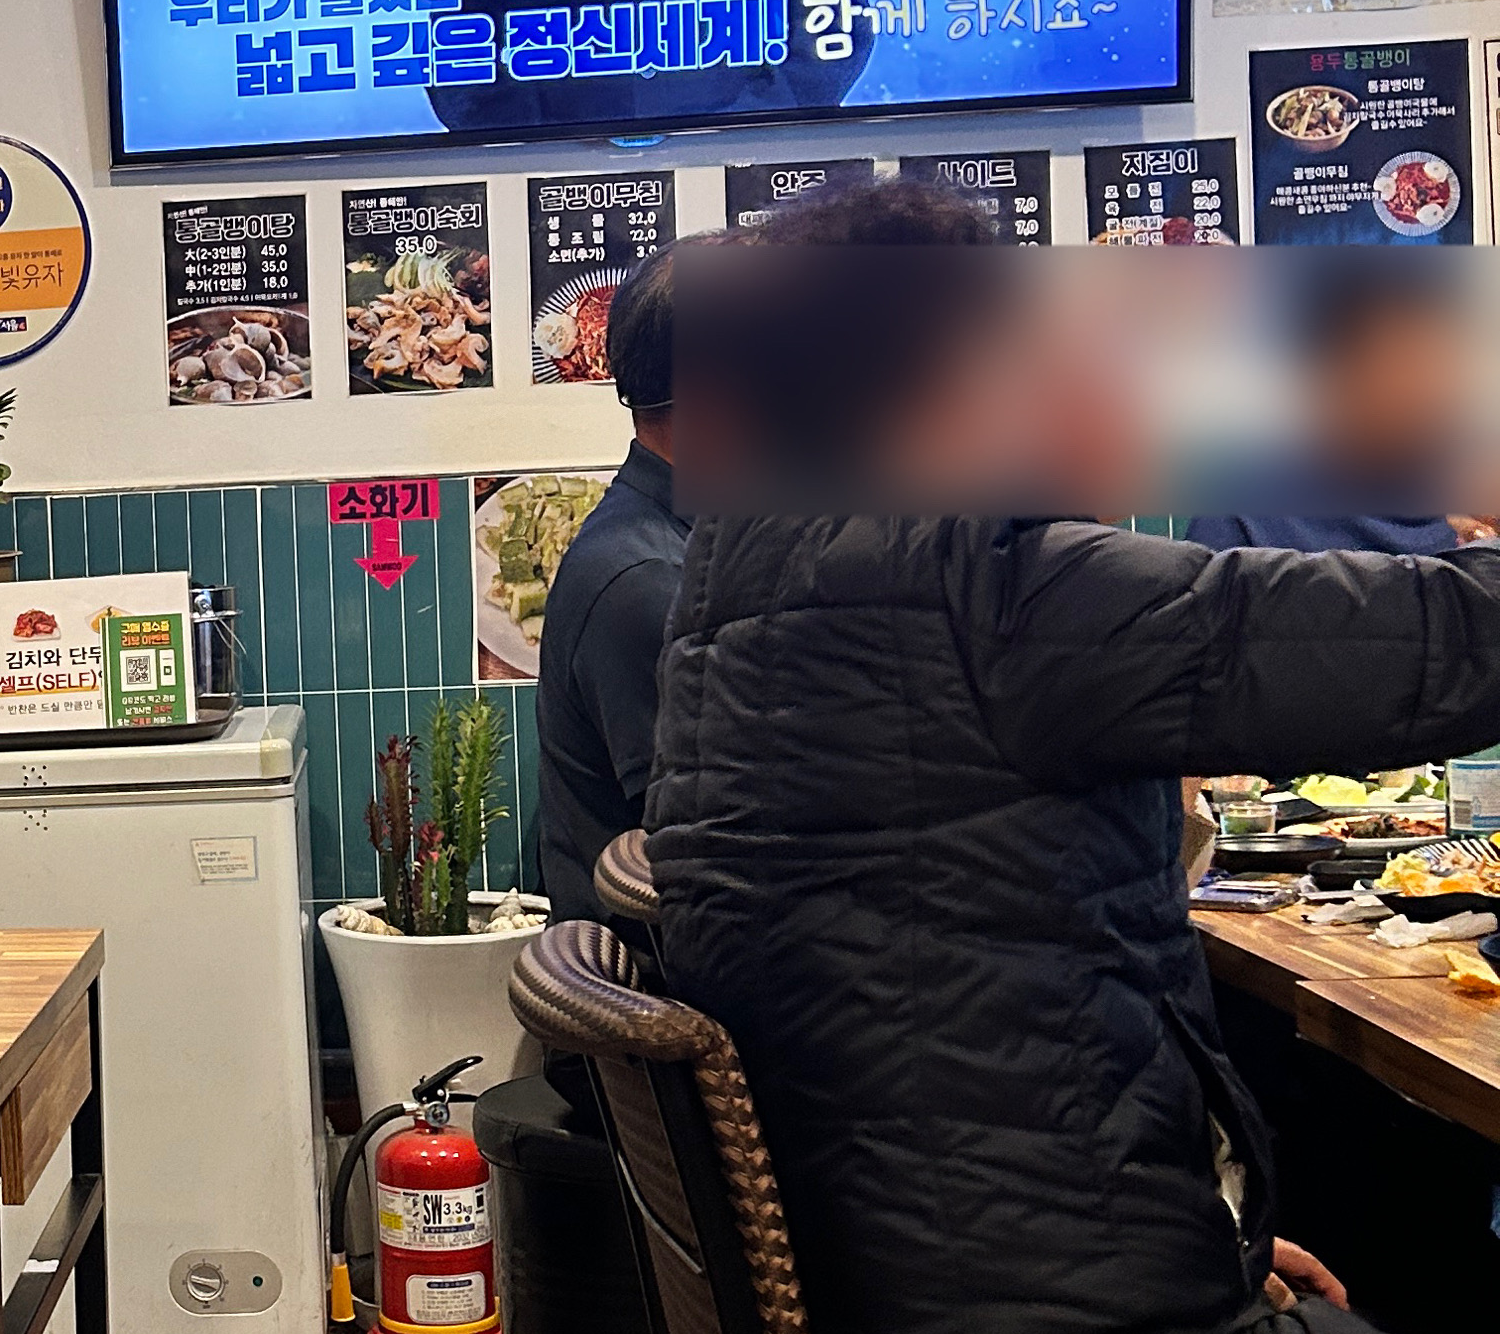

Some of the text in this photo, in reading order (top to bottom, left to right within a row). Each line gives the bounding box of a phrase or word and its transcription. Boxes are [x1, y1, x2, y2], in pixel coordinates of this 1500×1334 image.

[235, 25, 357, 98] 넓고
[371, 12, 496, 88] 깊은
[932, 159, 1017, 188] 사이드
[1121, 148, 1198, 177] 지짐이
[539, 181, 662, 212] 골뱅이무침
[175, 213, 295, 243] 통골뱅이탕
[348, 204, 482, 236] 통골뱅이숙회
[338, 483, 429, 519] 소화기
[6, 648, 61, 669] 김치와
[8, 704, 37, 715] 반찬은
[41, 702, 59, 712] 드실
[64, 700, 92, 711] 만큼만
[423, 1194, 442, 1225] SW
